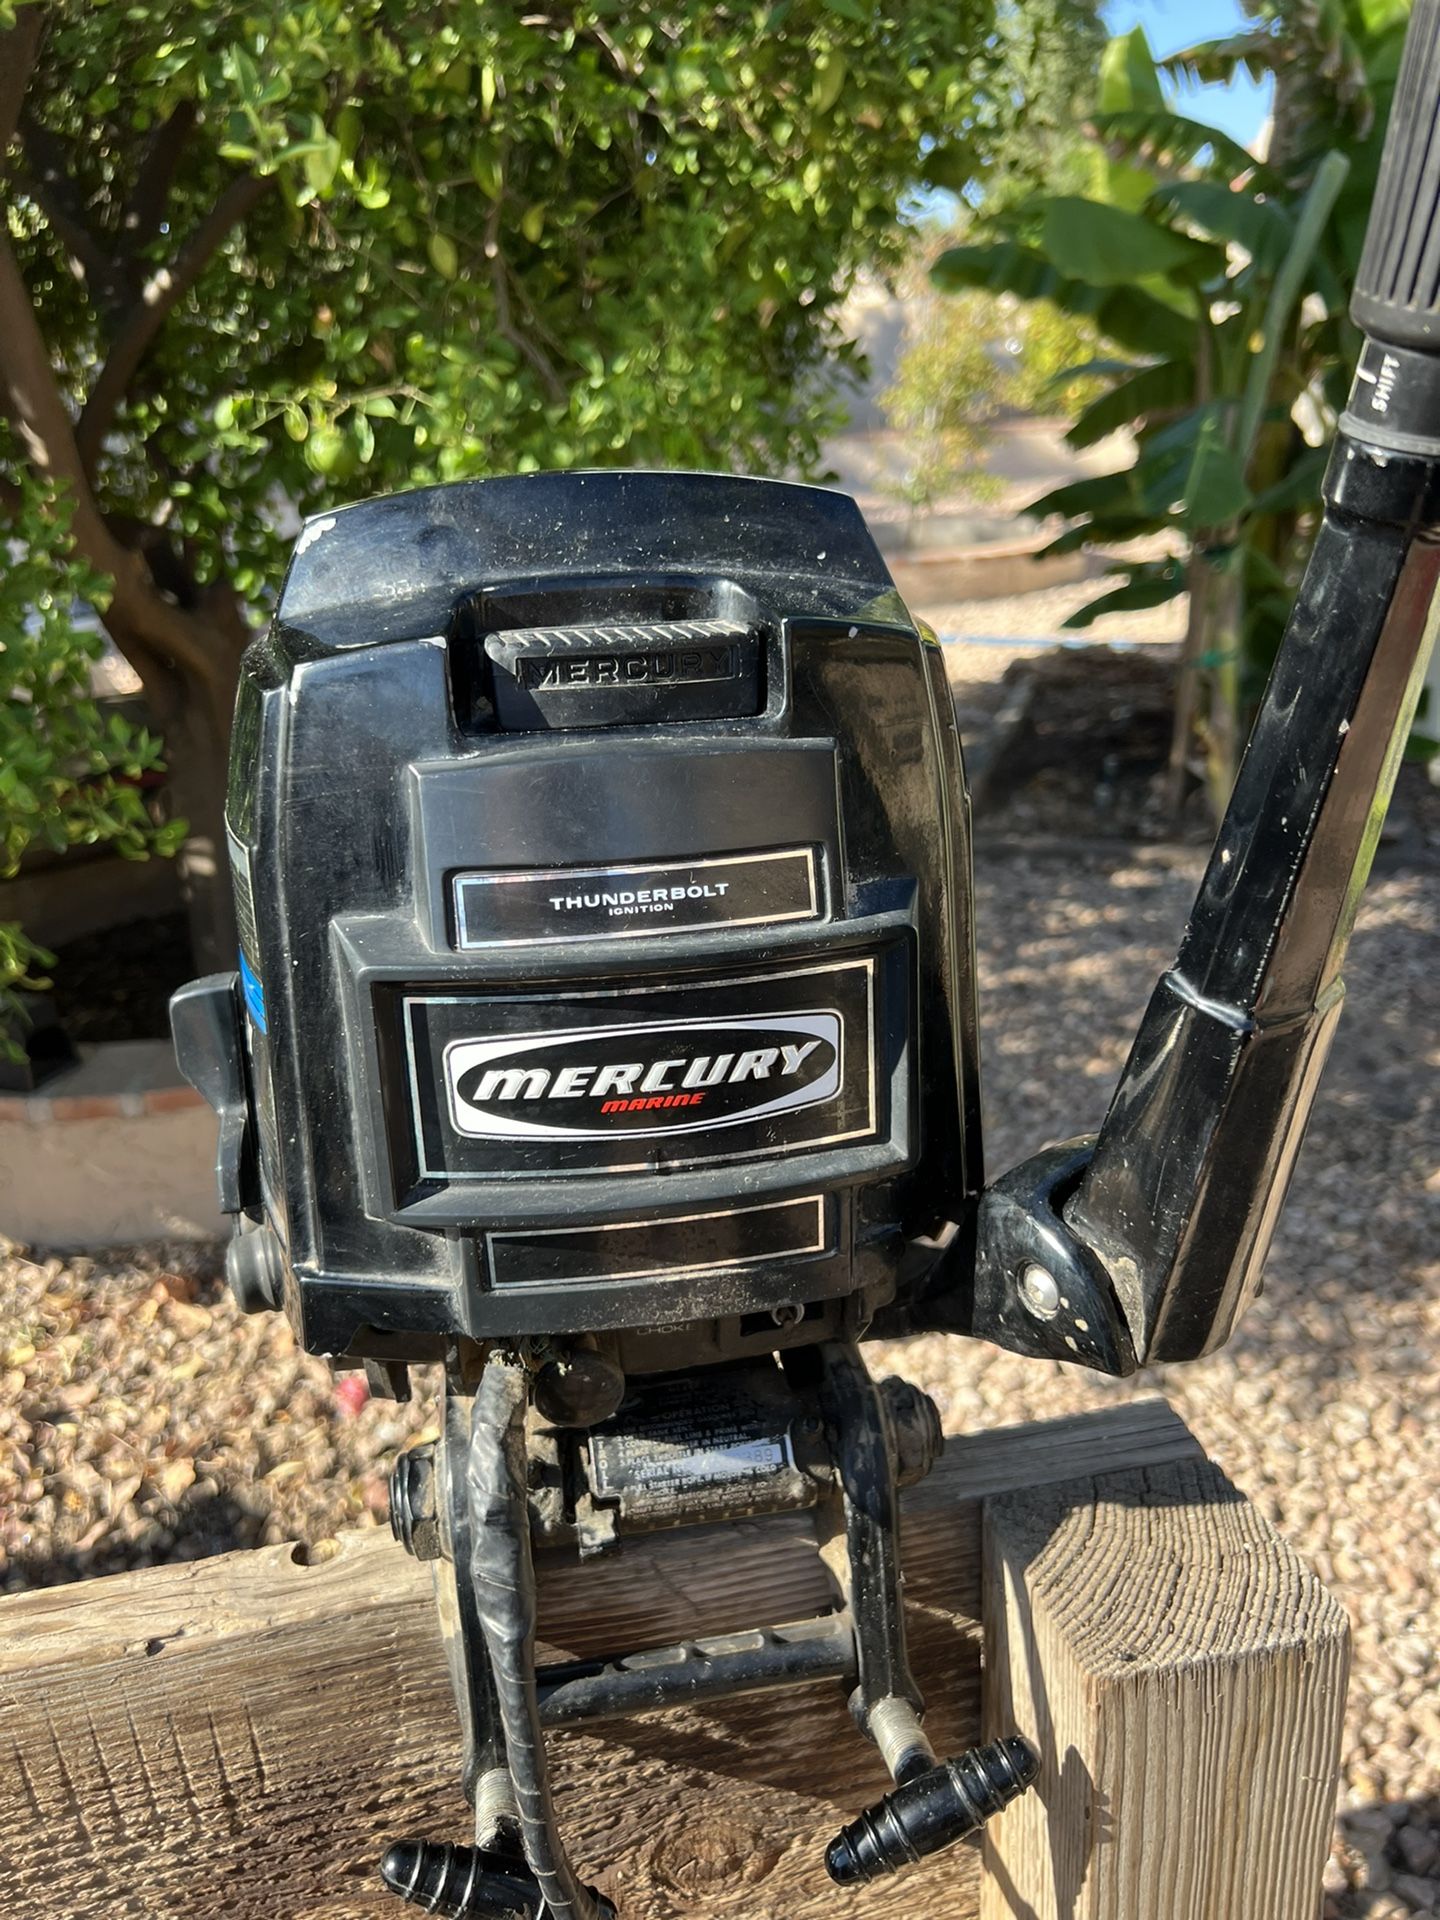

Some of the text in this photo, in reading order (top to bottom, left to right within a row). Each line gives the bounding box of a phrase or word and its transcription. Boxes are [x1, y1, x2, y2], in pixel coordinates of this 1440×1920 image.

[1371, 353, 1400, 413] SHIFT
[526, 648, 731, 689] MERCURY
[550, 883, 729, 911] THUNDERBOLT
[608, 902, 675, 916] IGNITION
[472, 1039, 822, 1101] MERCURY
[600, 1092, 706, 1114] MARINE
